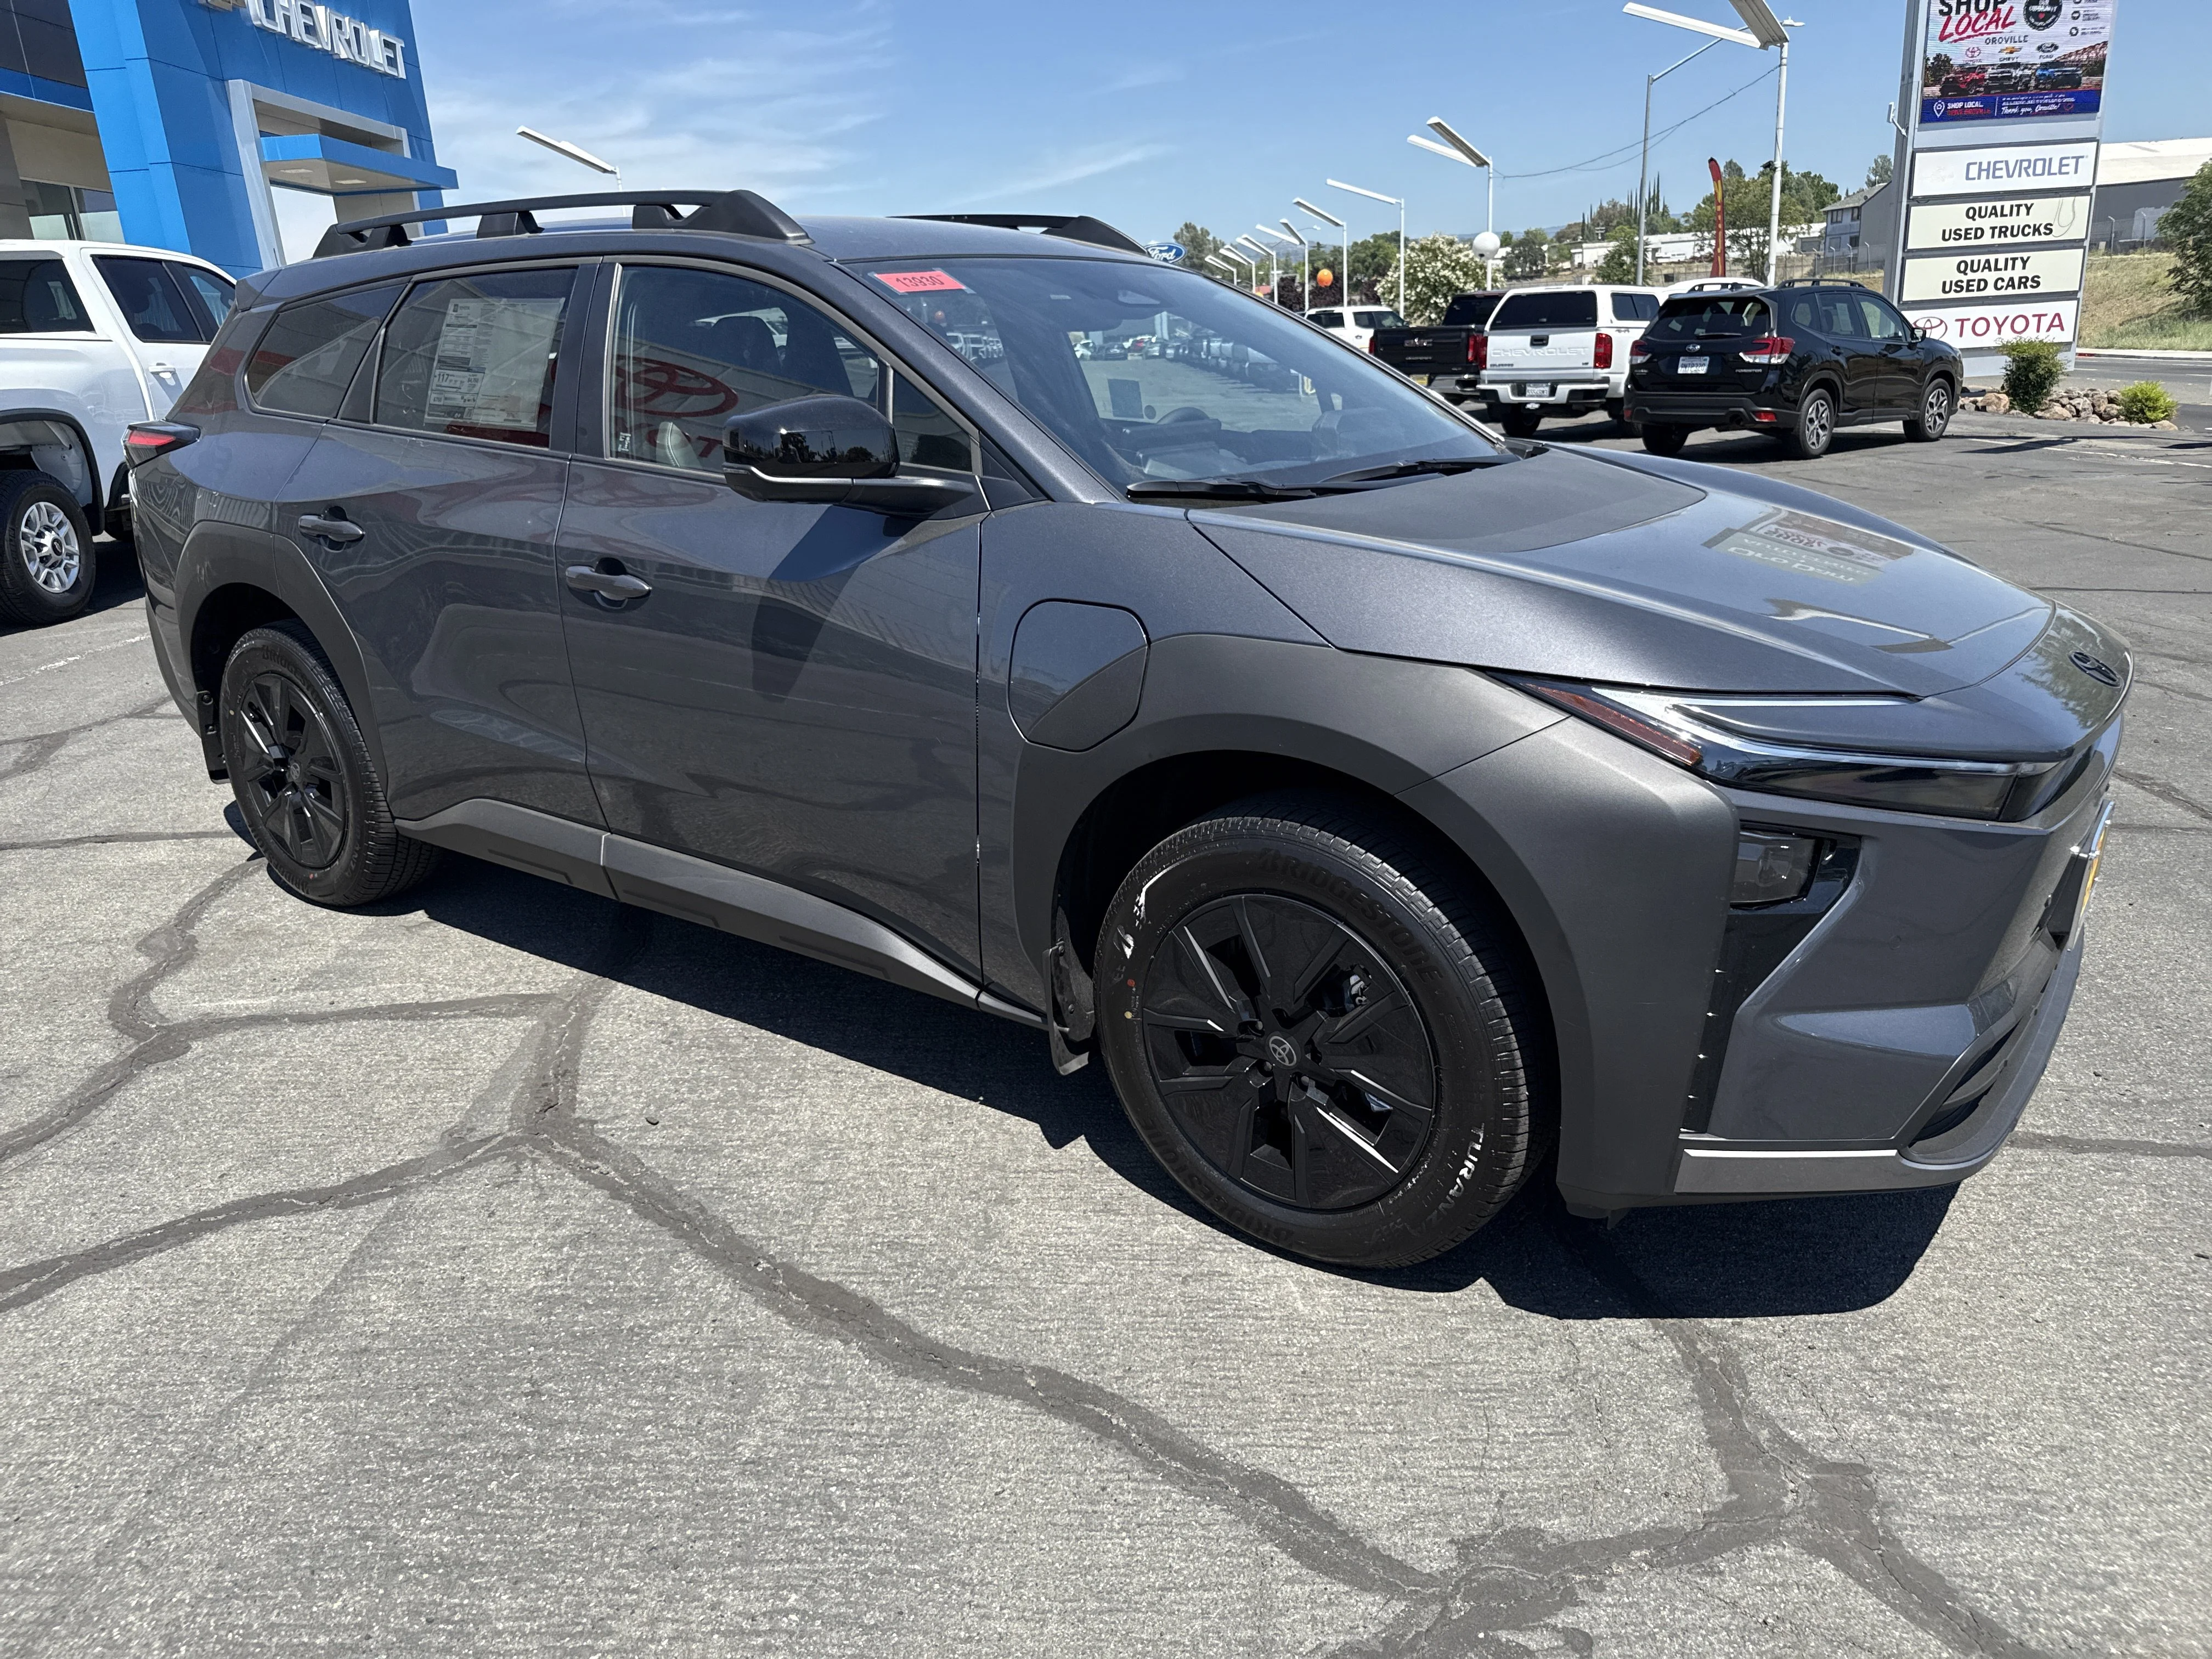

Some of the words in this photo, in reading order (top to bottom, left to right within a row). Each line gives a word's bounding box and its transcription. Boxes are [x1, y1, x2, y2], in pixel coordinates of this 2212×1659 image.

[1938, 5, 2017, 42] LOCAL
[247, 0, 407, 80] CHEVROLET
[1984, 35, 2029, 45] OROVILLE
[1965, 155, 2085, 181] CHEVROLET
[1965, 202, 2034, 221] QUALITY
[1941, 227, 1985, 242] USED
[1989, 222, 2053, 239] TRUCKS
[1148, 246, 1177, 261] Ford
[1956, 256, 2032, 275] QUALITY
[1941, 278, 1988, 294] USED
[1993, 274, 2041, 291] CARS
[1955, 312, 2065, 337] TOYOTA
[1490, 347, 1589, 358] CHEVROLET
[438, 373, 449, 382] 117
